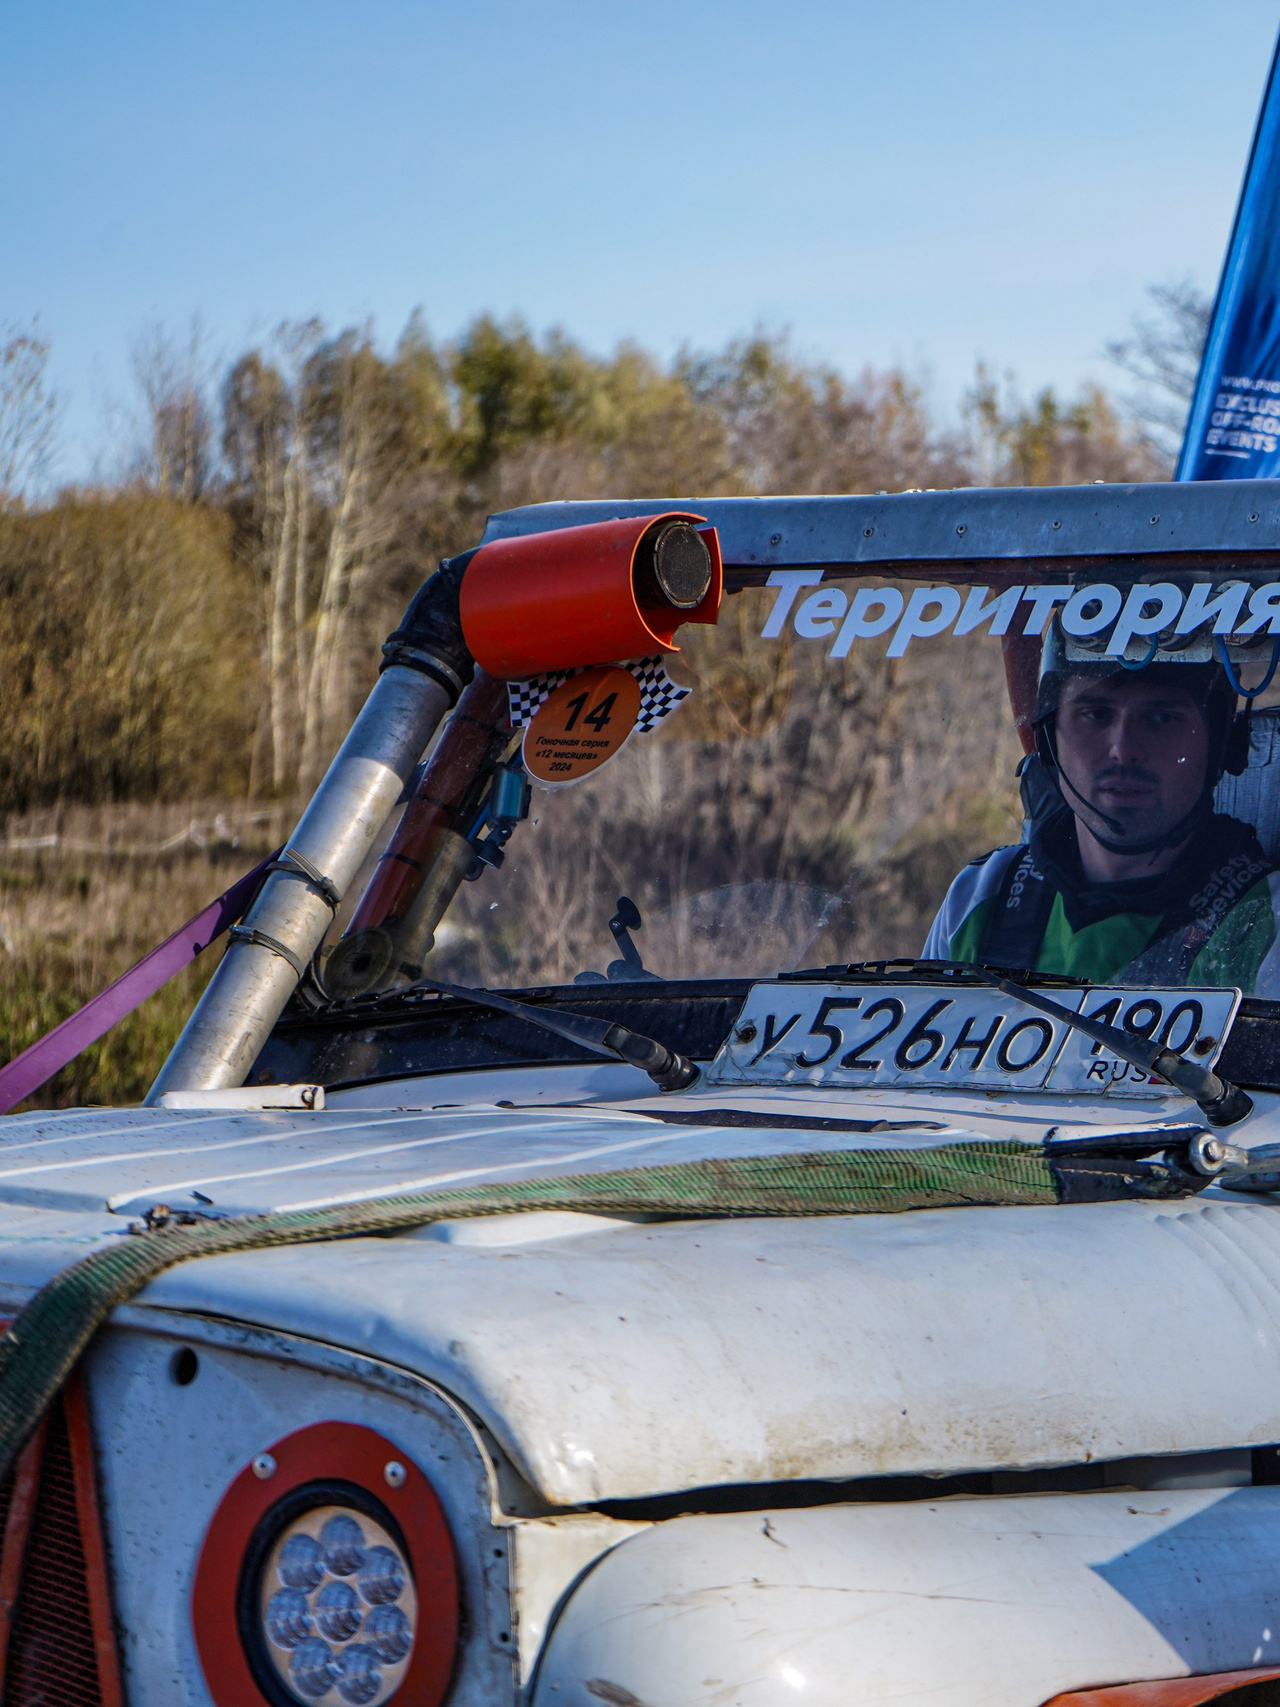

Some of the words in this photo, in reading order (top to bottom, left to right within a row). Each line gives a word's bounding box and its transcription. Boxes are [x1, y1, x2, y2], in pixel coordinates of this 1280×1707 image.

[1206, 428, 1277, 453] EVENTS
[564, 691, 618, 732] 14
[536, 736, 579, 746] Гоночная
[581, 739, 609, 748] серия
[549, 762, 572, 771] 2024
[1188, 854, 1252, 912] Safety
[1087, 997, 1204, 1056] 190
[1086, 1060, 1148, 1083] RUS
